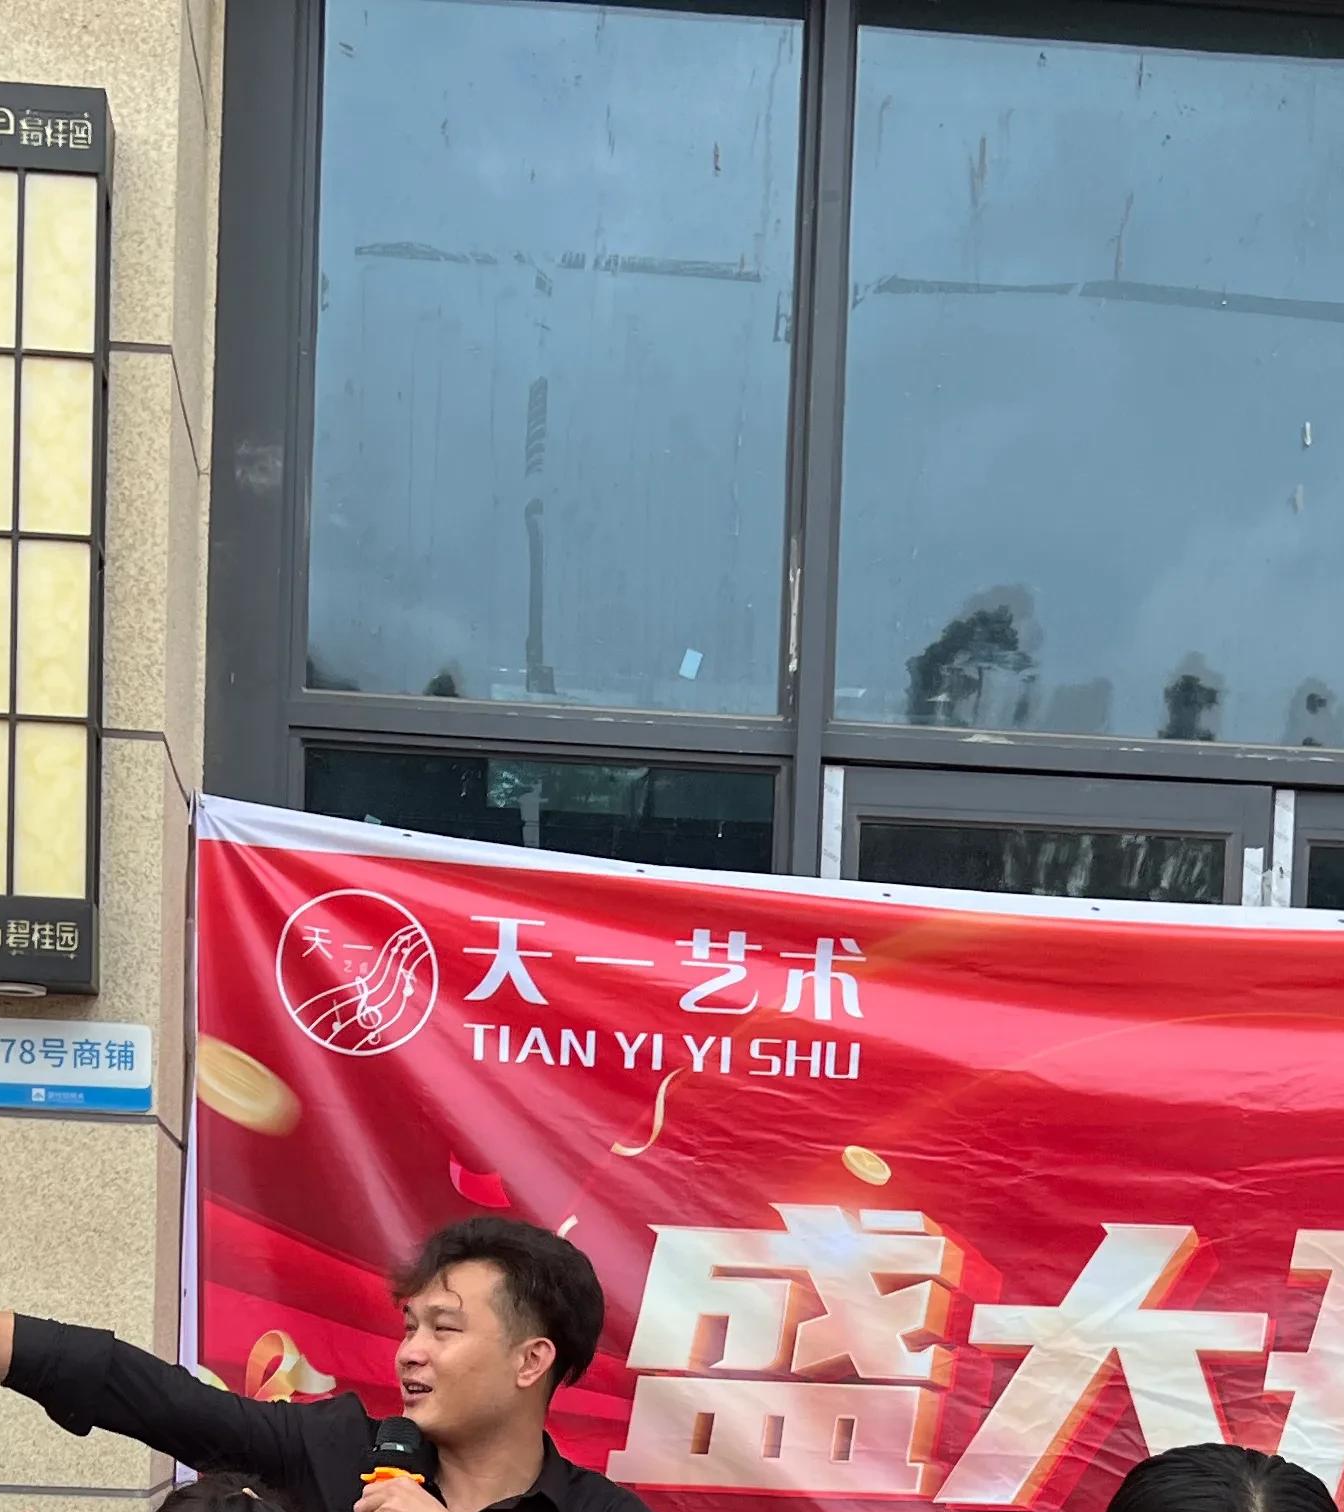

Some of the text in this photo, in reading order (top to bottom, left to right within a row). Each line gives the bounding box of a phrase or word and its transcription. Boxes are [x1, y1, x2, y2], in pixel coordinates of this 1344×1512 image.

[463, 915, 867, 1021] 天一艺术
[463, 1023, 860, 1080] TIAN YI YI SHU
